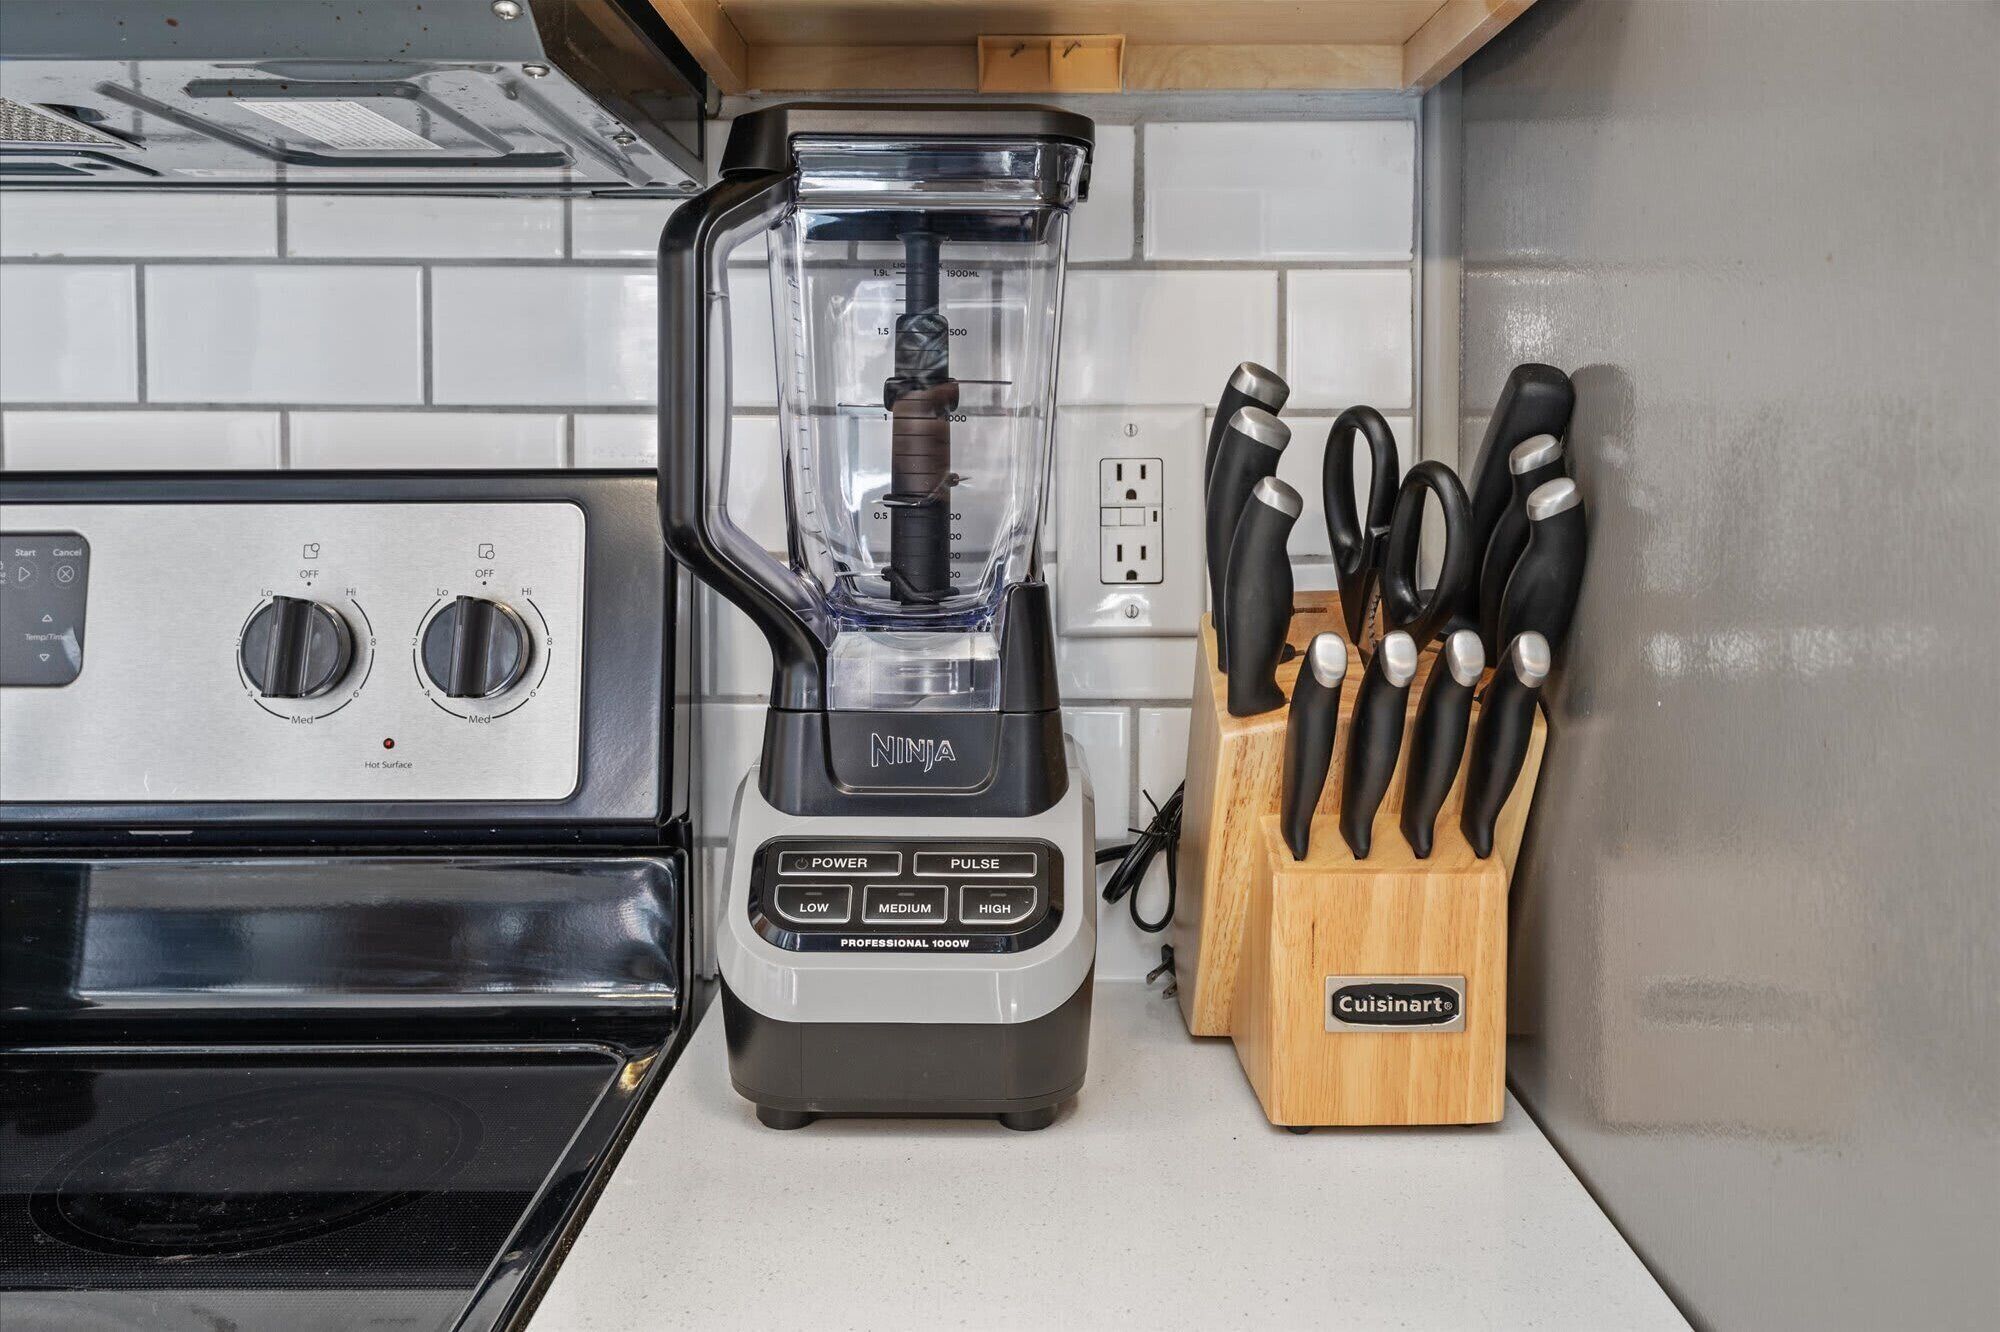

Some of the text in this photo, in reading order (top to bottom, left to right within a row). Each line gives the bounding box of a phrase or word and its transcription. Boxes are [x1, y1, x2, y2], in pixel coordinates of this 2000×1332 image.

[946, 269, 980, 278] 1900ML
[877, 327, 889, 336] 1.5
[946, 328, 967, 337] 500
[873, 512, 888, 520] 0.5
[15, 548, 36, 557] Start
[52, 548, 82, 557] Cancel
[299, 569, 319, 579] OFF
[475, 569, 495, 578] OFF
[260, 588, 273, 597] Lo
[345, 588, 357, 596] Hi
[436, 588, 449, 597] Lo
[521, 587, 532, 596] Hi
[370, 638, 377, 646] 8
[412, 638, 418, 646] 2
[546, 637, 553, 646] 8
[353, 689, 359, 698] 6
[424, 689, 431, 698] 4
[529, 689, 536, 698] 6
[291, 715, 314, 725] Med
[468, 715, 491, 724] Med
[871, 732, 956, 773] NINJA
[364, 760, 413, 769] Hot Surface
[811, 857, 868, 869] POWER
[950, 859, 1000, 870] PULSE
[799, 902, 829, 914] LOW
[878, 903, 932, 914] MEDIUM
[979, 904, 1011, 914] HIGH
[840, 938, 970, 949] PROFESSIONAL 1000W
